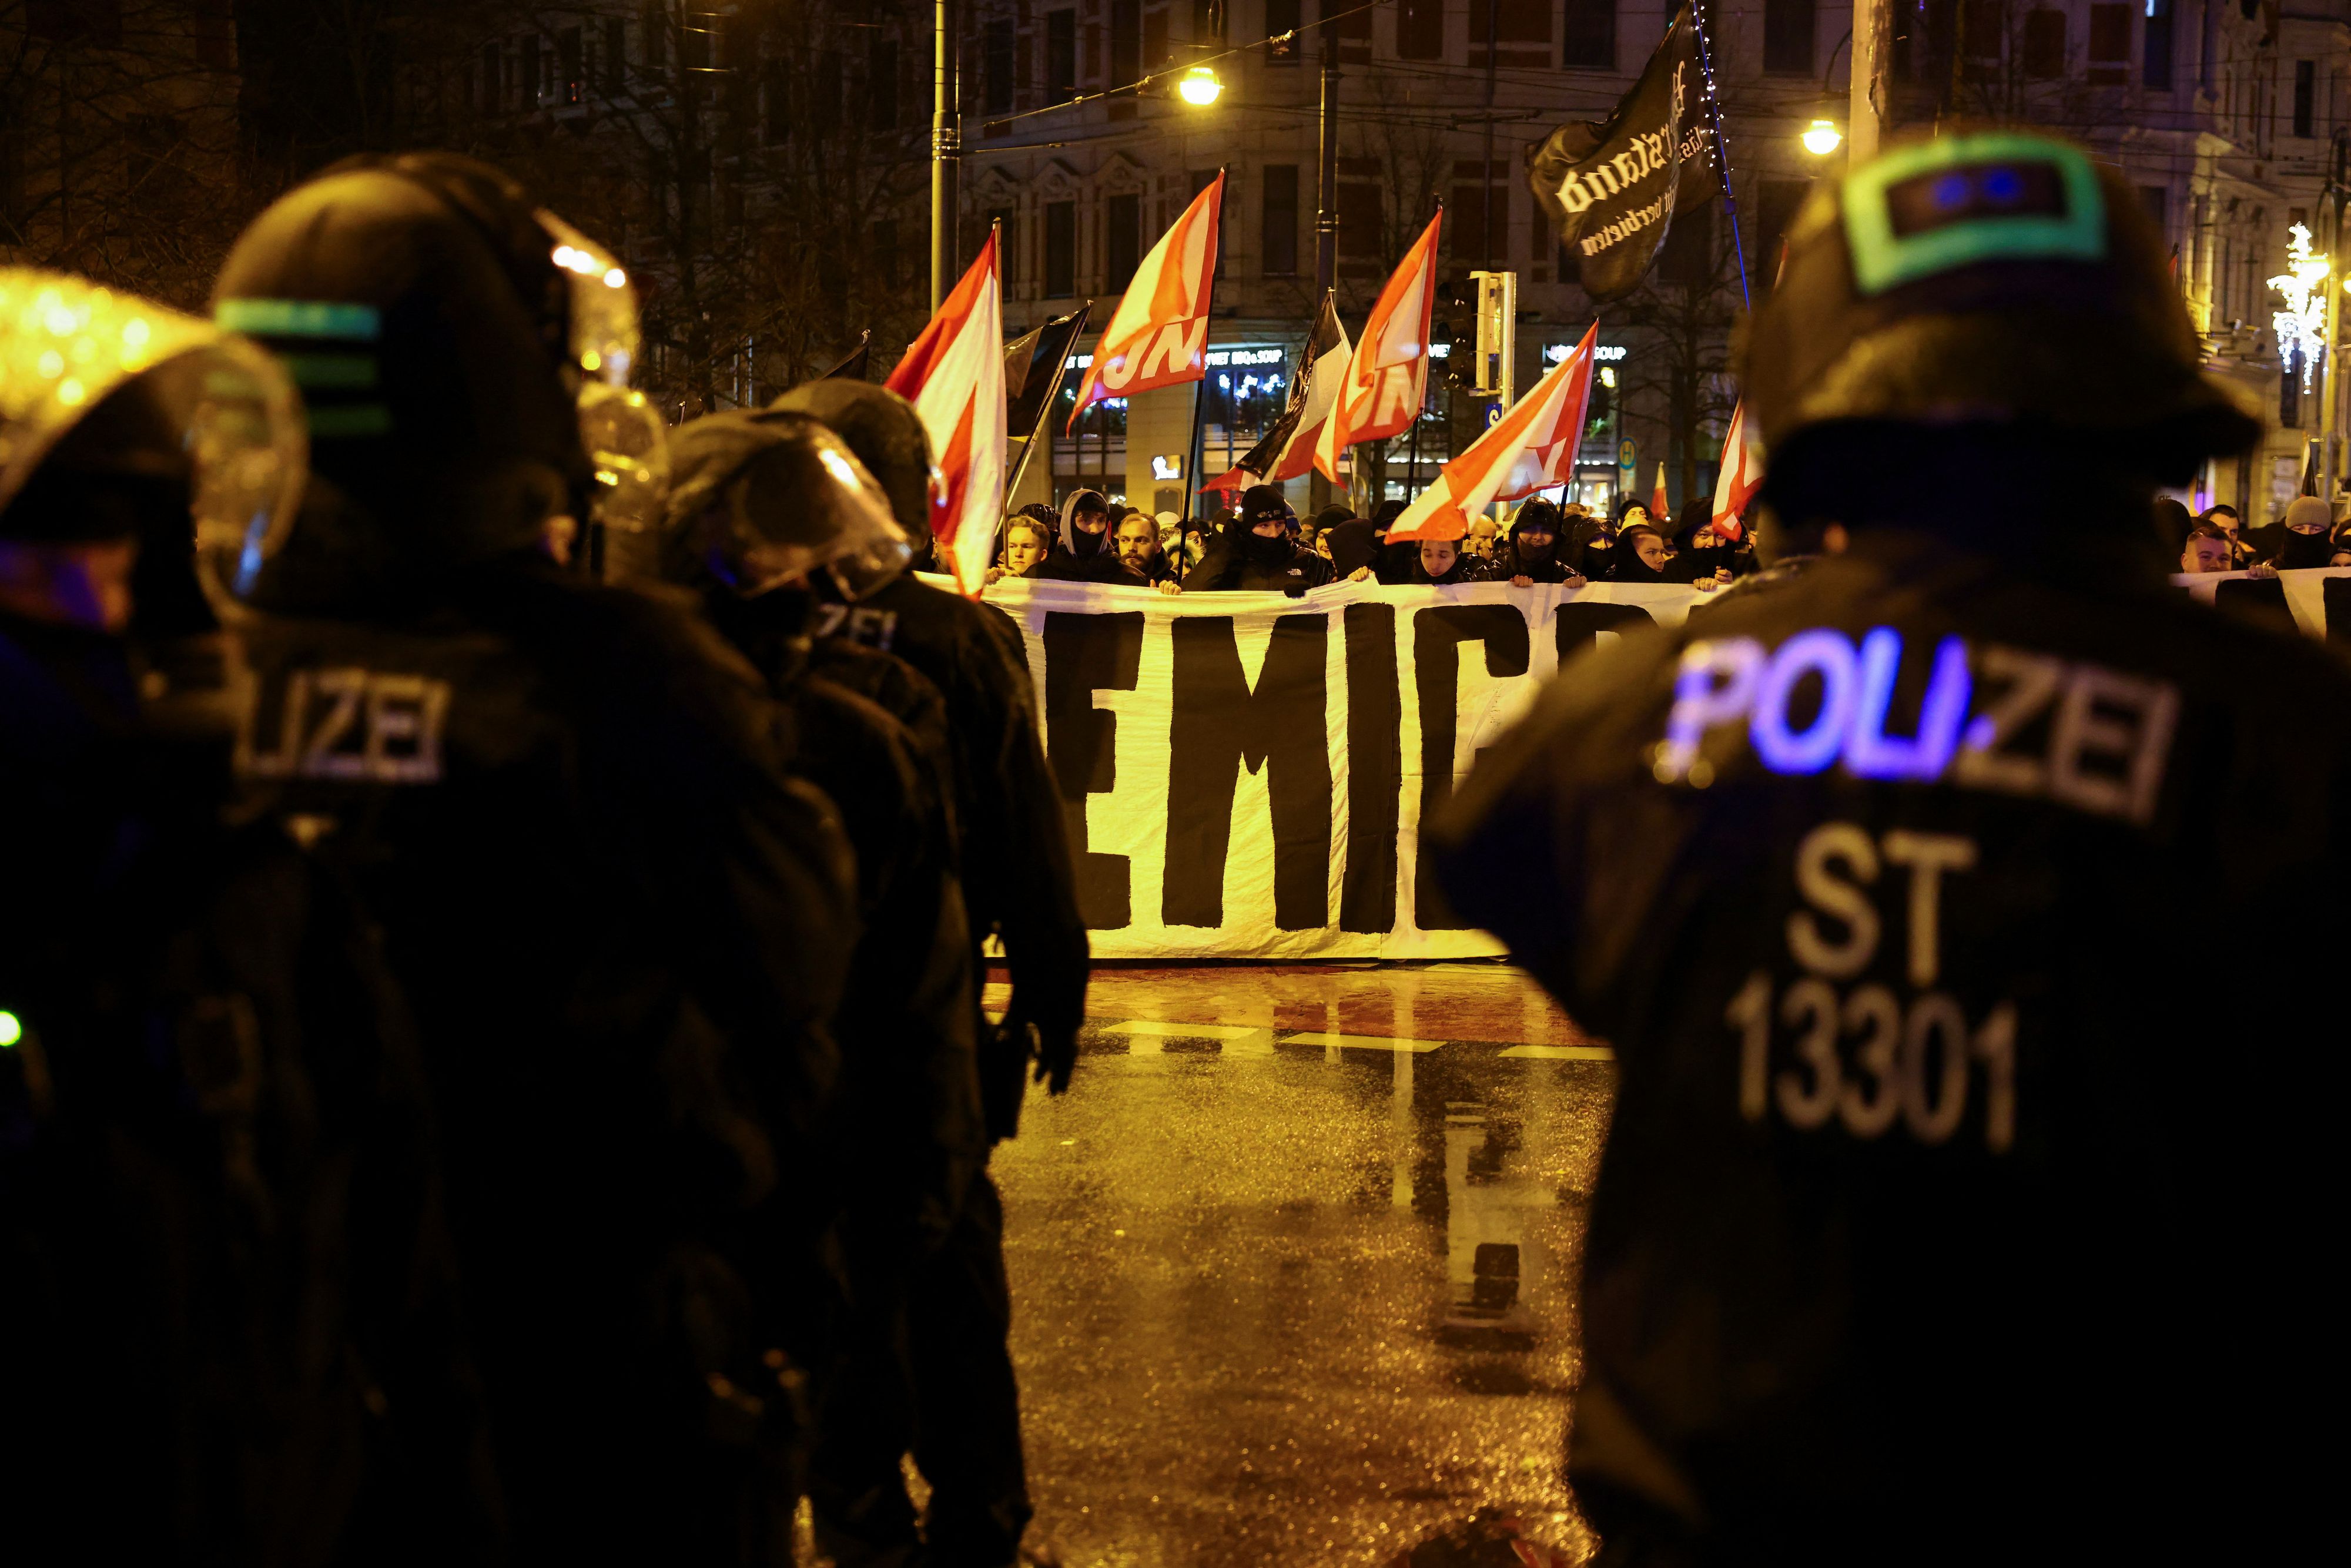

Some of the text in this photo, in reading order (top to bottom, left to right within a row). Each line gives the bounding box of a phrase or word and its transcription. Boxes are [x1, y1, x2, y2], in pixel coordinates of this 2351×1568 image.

[1659, 624, 2183, 824] POLIZEI
[1784, 822, 1981, 987] ST
[1723, 968, 2020, 1155] 13301
